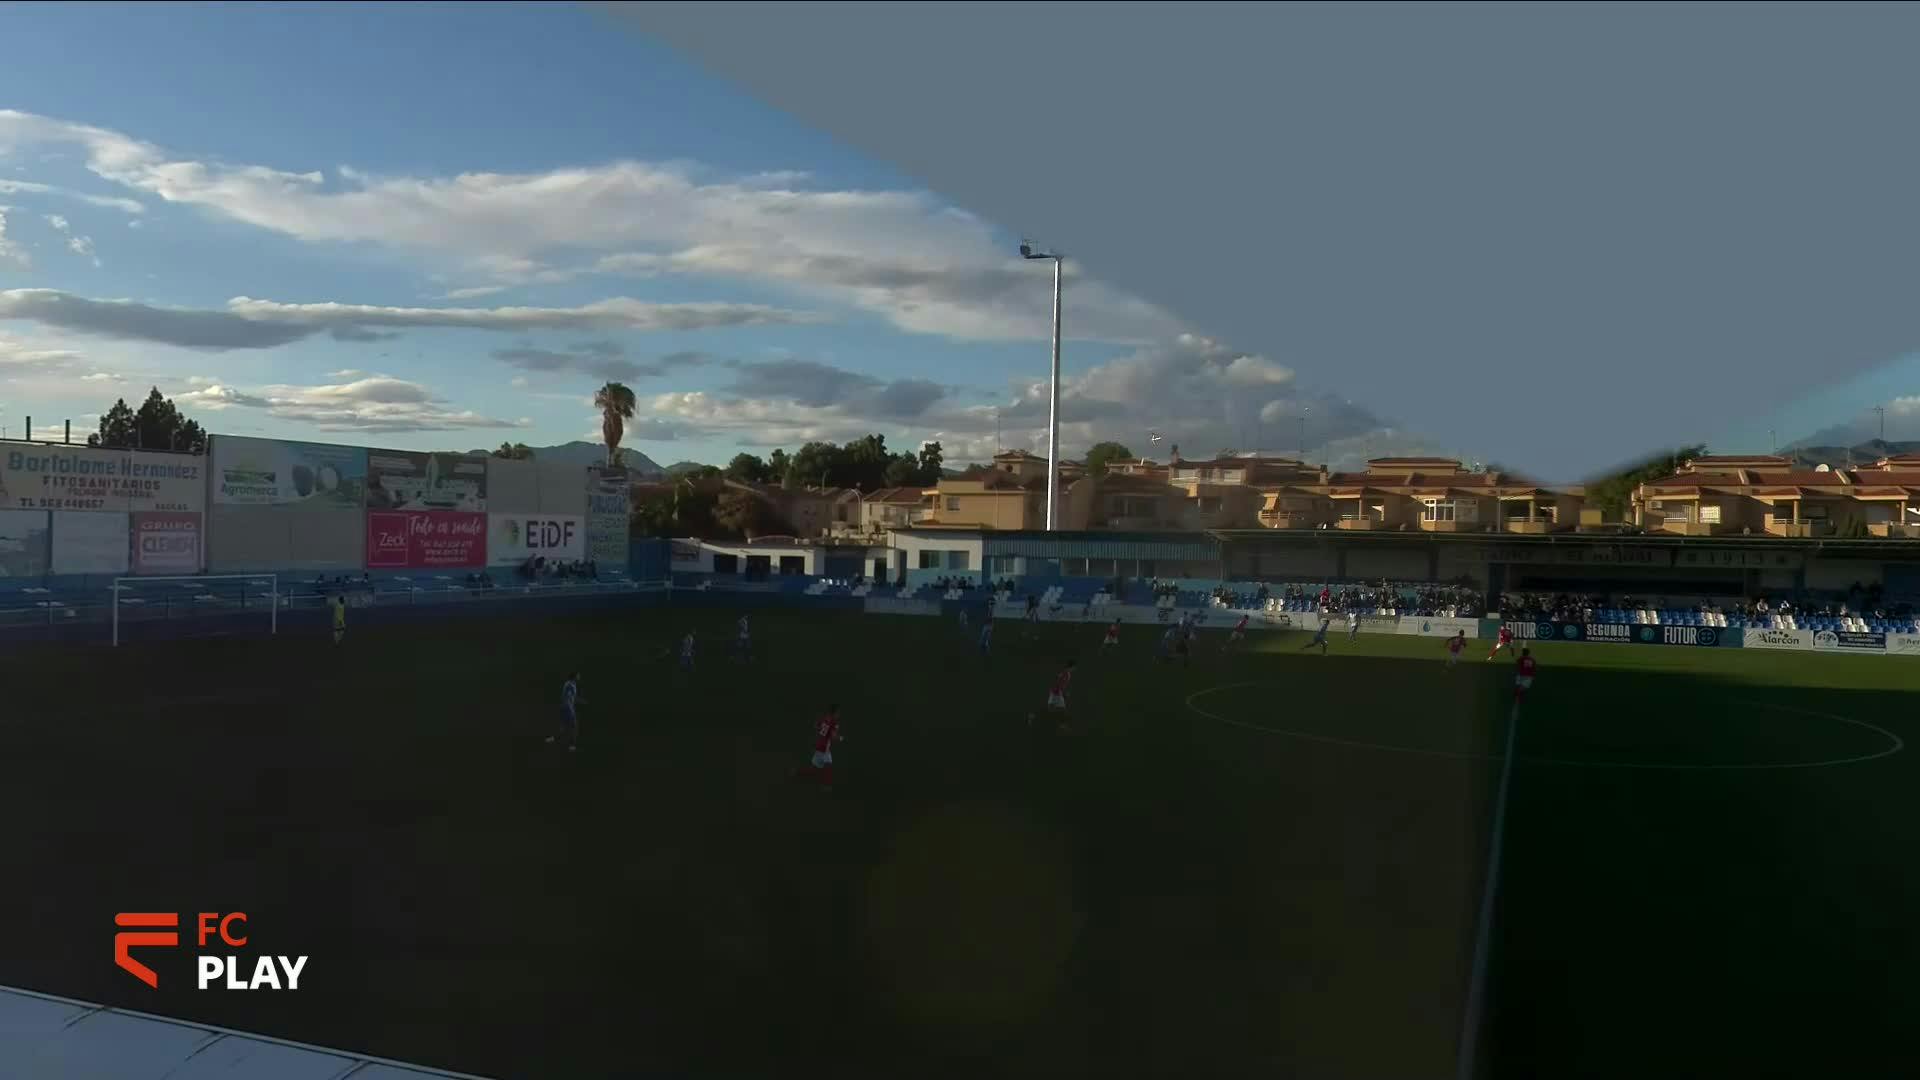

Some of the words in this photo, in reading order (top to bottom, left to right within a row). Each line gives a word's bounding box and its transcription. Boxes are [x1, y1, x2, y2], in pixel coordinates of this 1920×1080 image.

[7, 451, 115, 475] Bartolome
[121, 458, 199, 479] Hernandez
[43, 476, 160, 490] FITOSANITARIOS
[527, 521, 575, 548] EiDF
[1586, 623, 1630, 637] SEGUNDA
